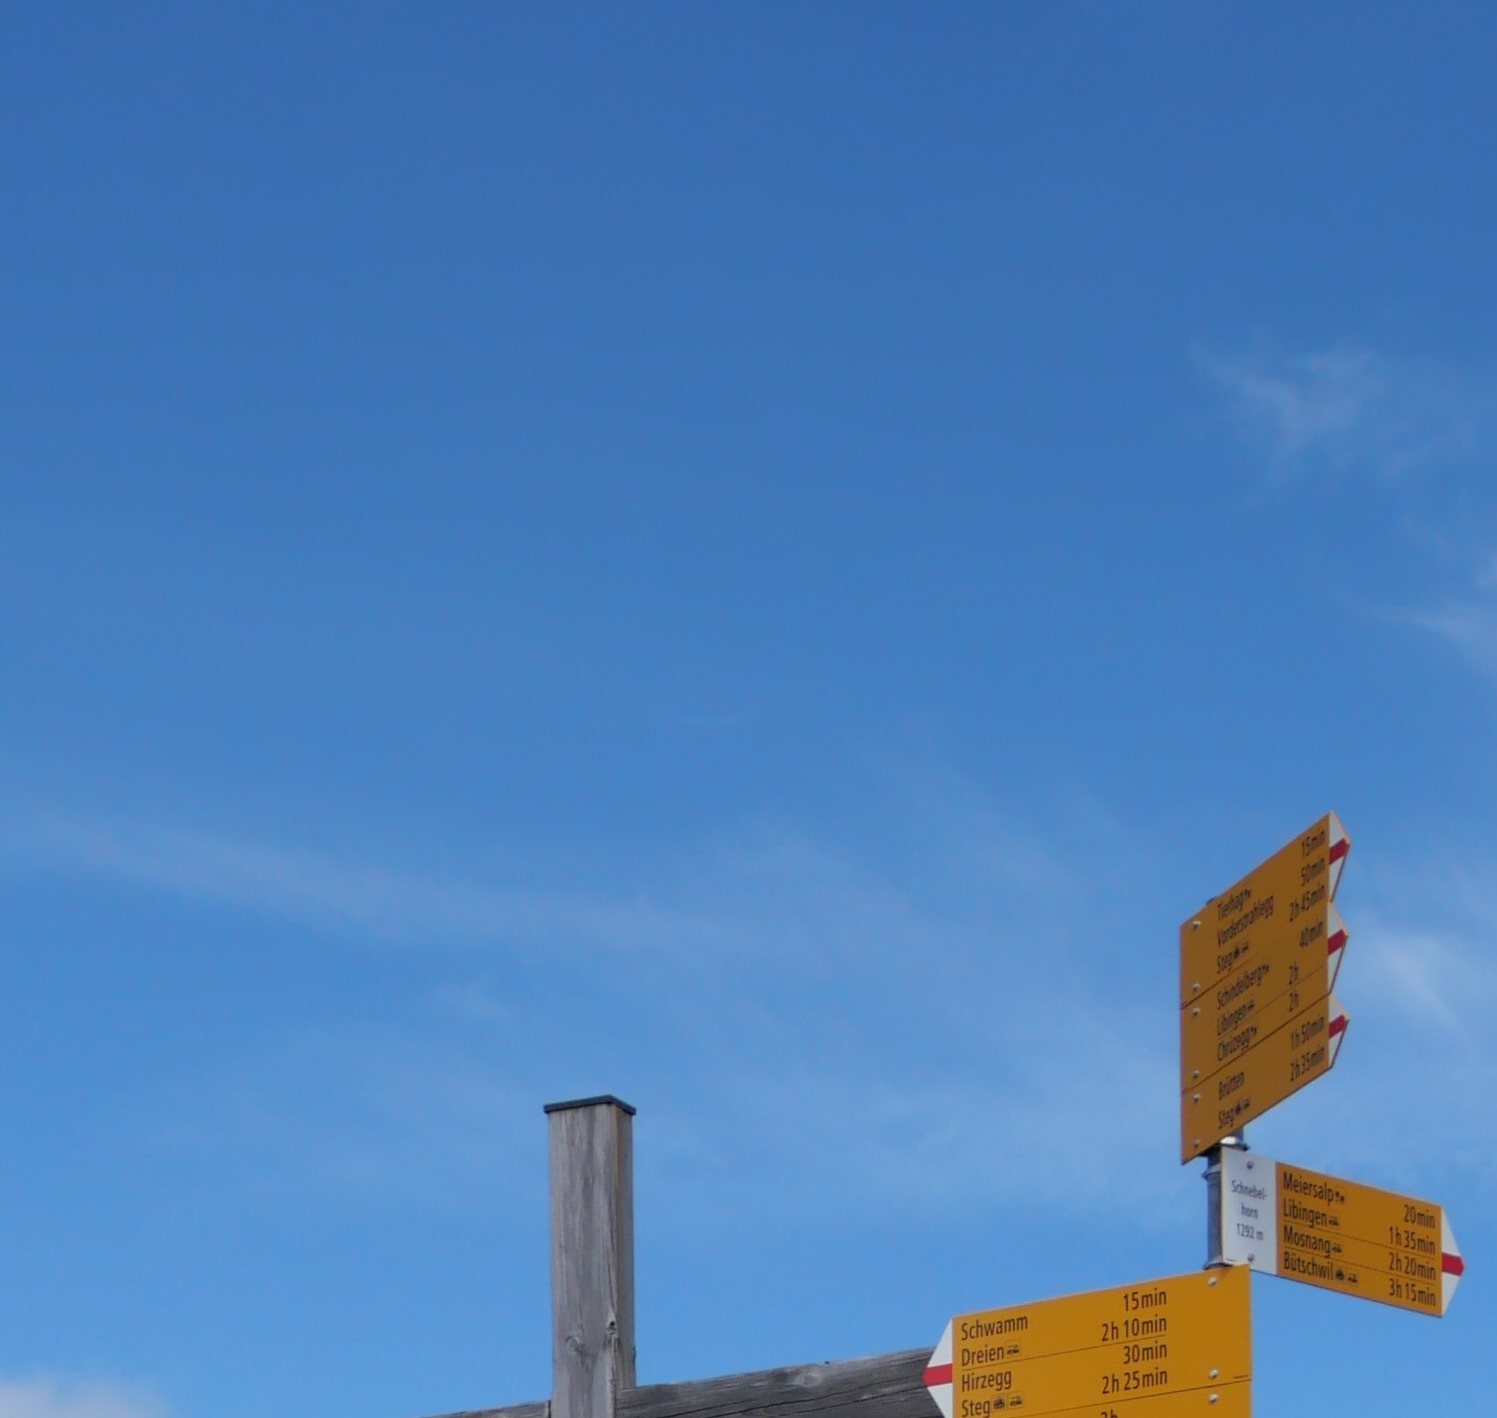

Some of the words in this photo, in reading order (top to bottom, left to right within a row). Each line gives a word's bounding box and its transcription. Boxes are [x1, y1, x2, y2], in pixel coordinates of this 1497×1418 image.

[1217, 890, 1244, 920] Tierhag
[1217, 952, 1234, 974] Steg
[1289, 962, 1300, 985] 2h
[1289, 989, 1300, 1012] 2h
[1217, 1003, 1247, 1036] Libingen
[1218, 1110, 1235, 1130] Steg
[1231, 1179, 1268, 1199] Schnebel-
[1283, 1171, 1334, 1206] Meiersalp
[1241, 1203, 1259, 1219] horn
[1283, 1198, 1328, 1229] Libingen
[1236, 1223, 1255, 1241] 1292
[1256, 1230, 1264, 1241] m
[1283, 1225, 1331, 1258] Mosnang
[1283, 1251, 1334, 1281] Bütschwil
[1123, 1288, 1167, 1312] 15min
[961, 1313, 1028, 1341] Schwamm
[1124, 1316, 1167, 1339] 10min
[961, 1344, 1005, 1367] Dreien
[1123, 1342, 1167, 1366] 30min
[961, 1369, 1012, 1393] Hirzegg
[1124, 1369, 1168, 1392] 25min
